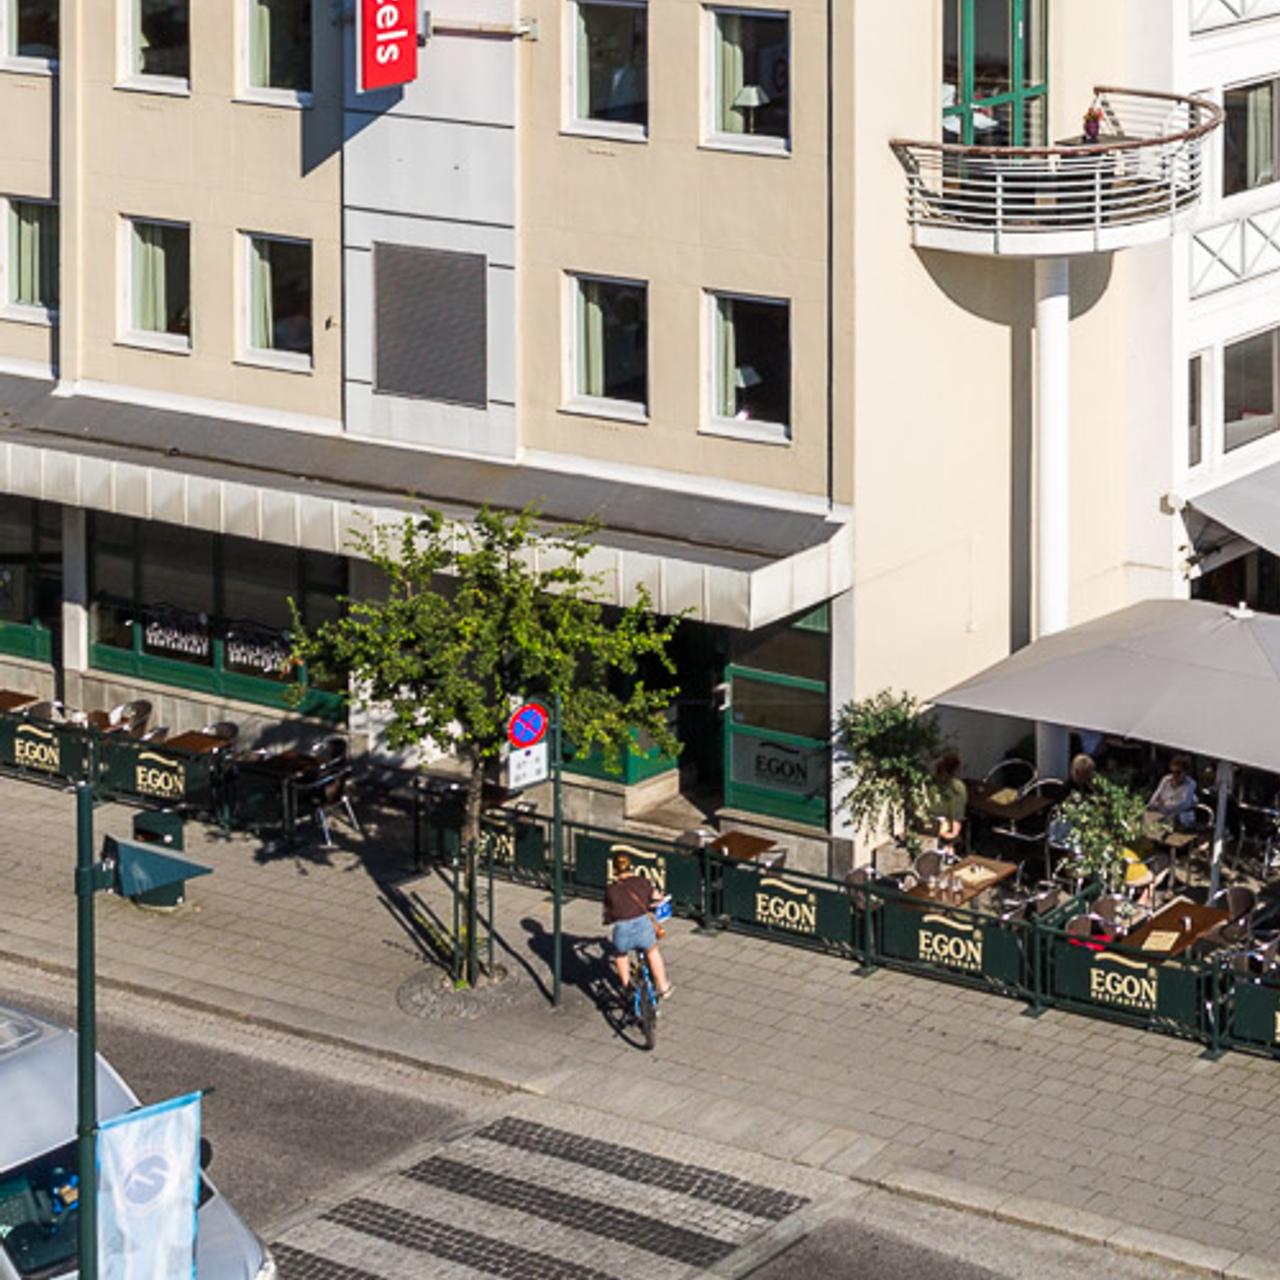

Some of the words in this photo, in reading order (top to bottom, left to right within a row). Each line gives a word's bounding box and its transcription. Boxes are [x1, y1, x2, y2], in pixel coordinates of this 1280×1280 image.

[14, 737, 60, 765] EGON
[136, 765, 186, 793] EGON
[755, 754, 808, 785] EGON
[756, 892, 816, 926] EGON
[918, 929, 982, 964] EGON
[1090, 968, 1157, 1003] EGON
